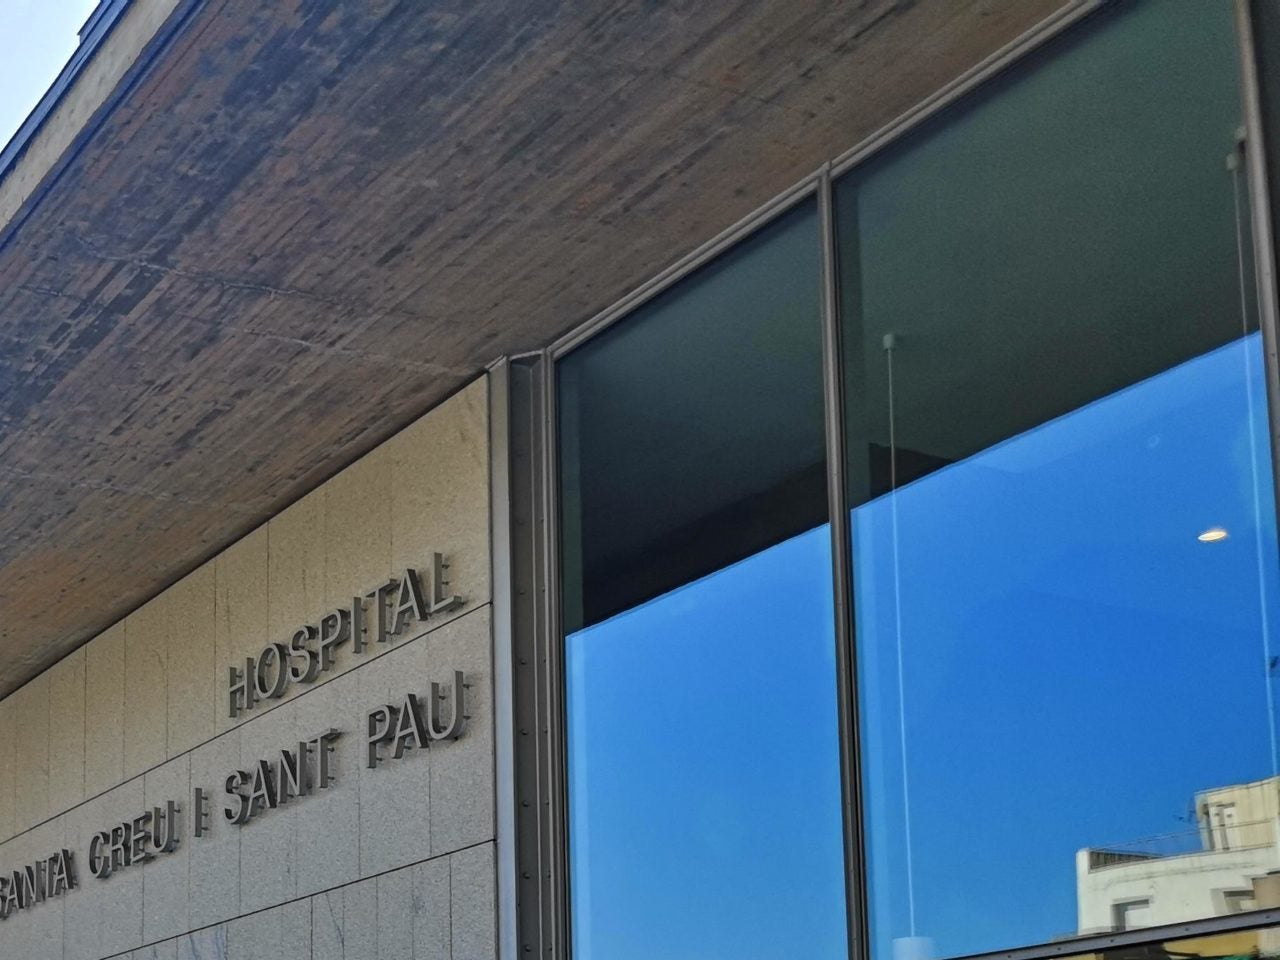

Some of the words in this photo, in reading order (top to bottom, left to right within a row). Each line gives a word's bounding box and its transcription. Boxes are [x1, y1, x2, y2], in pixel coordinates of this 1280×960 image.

[228, 552, 463, 718] HOSPITAL
[89, 800, 179, 879] CREU
[194, 786, 209, 838] I
[224, 727, 342, 825] SANT
[367, 670, 472, 769] PAU
